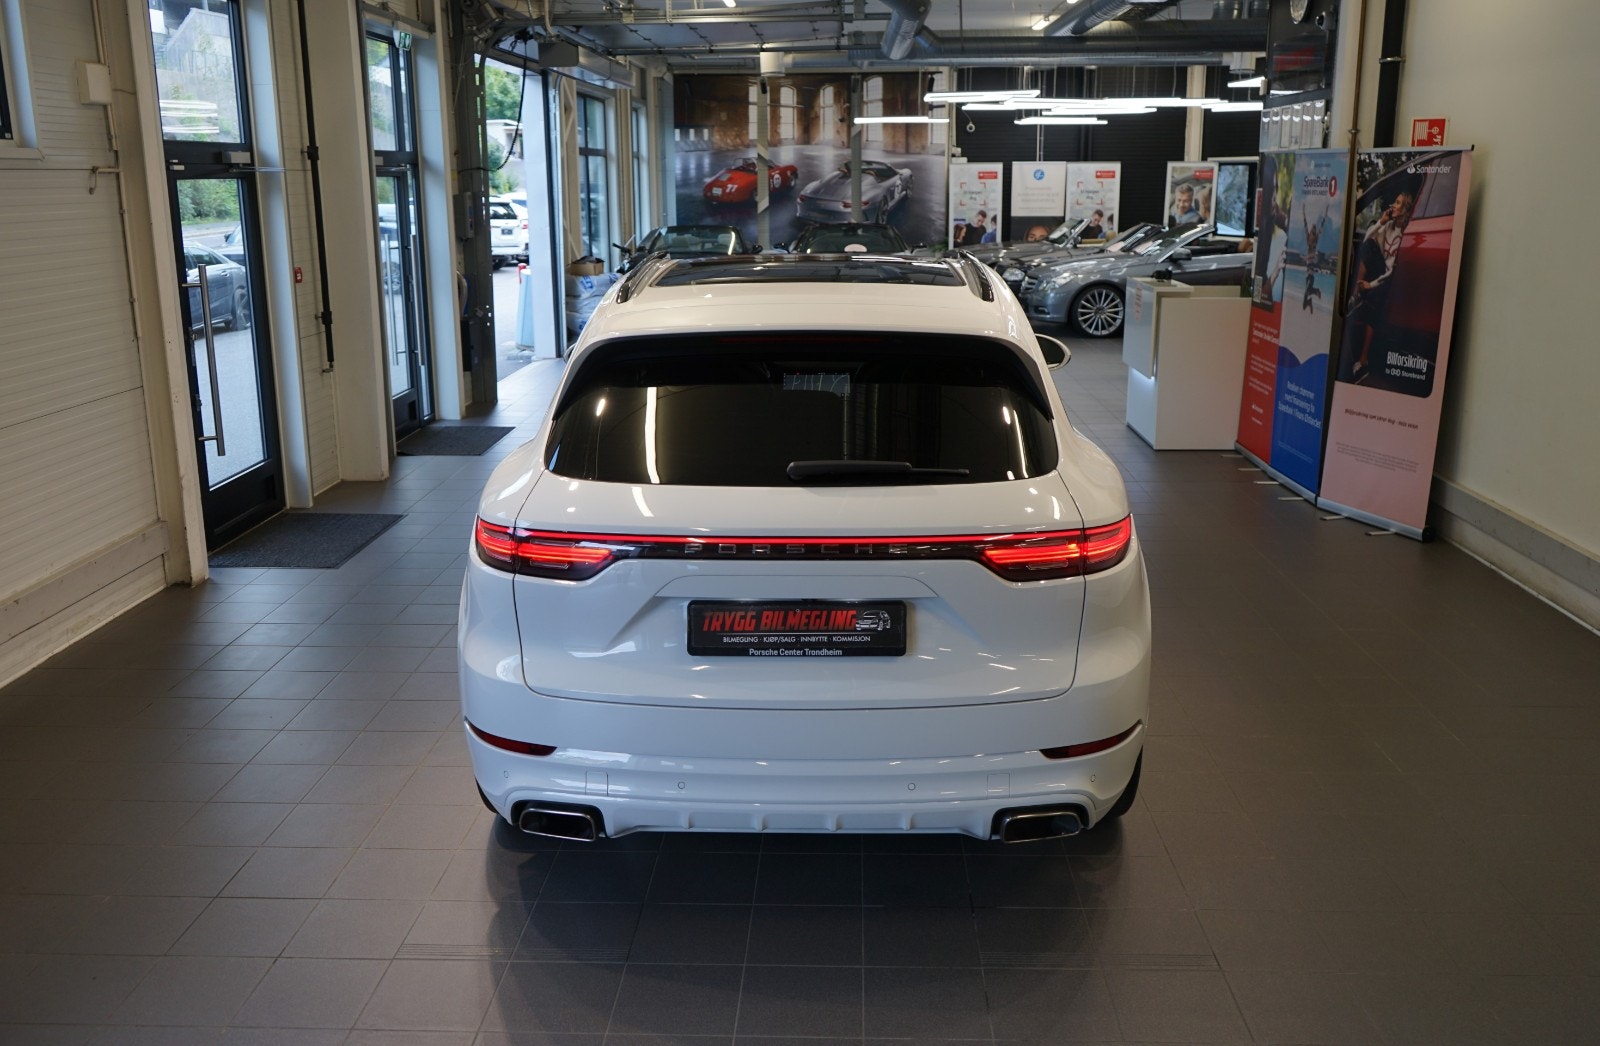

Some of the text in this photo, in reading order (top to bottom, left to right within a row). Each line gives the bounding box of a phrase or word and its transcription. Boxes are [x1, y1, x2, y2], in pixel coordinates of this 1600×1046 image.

[1416, 164, 1451, 174] Santander
[1386, 351, 1428, 373] Bilforsikring
[684, 543, 908, 554] PORSCHE
[703, 610, 857, 632] TRYGG BILMEGLING
[749, 648, 843, 656] Porsche Center Trondheim
